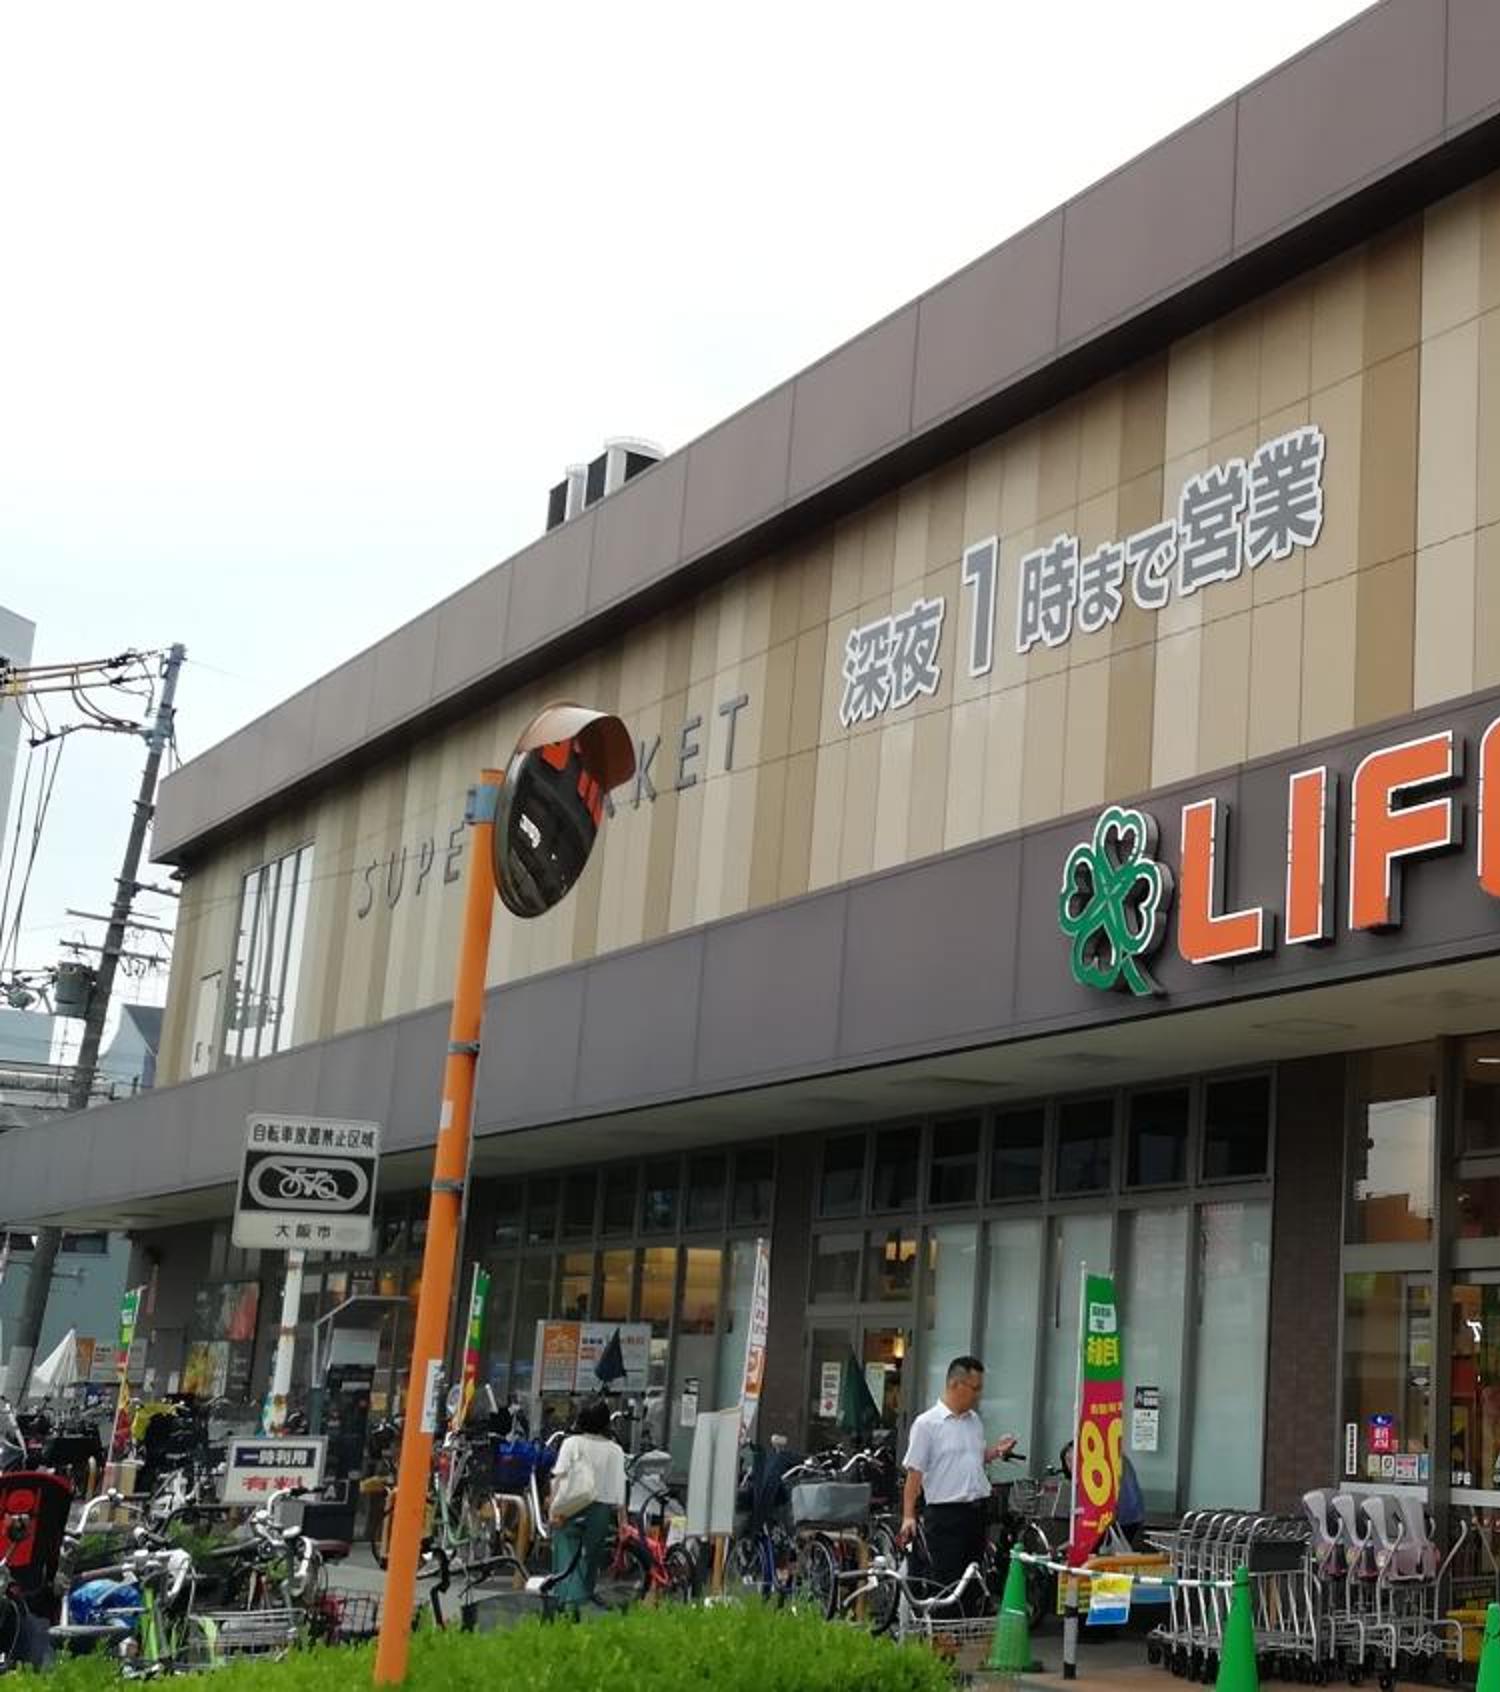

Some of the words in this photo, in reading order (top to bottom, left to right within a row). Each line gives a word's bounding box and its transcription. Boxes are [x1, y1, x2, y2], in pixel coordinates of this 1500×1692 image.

[253, 1123, 376, 1149] 自転車放置禁止区域
[274, 1223, 331, 1241] 大阪市
